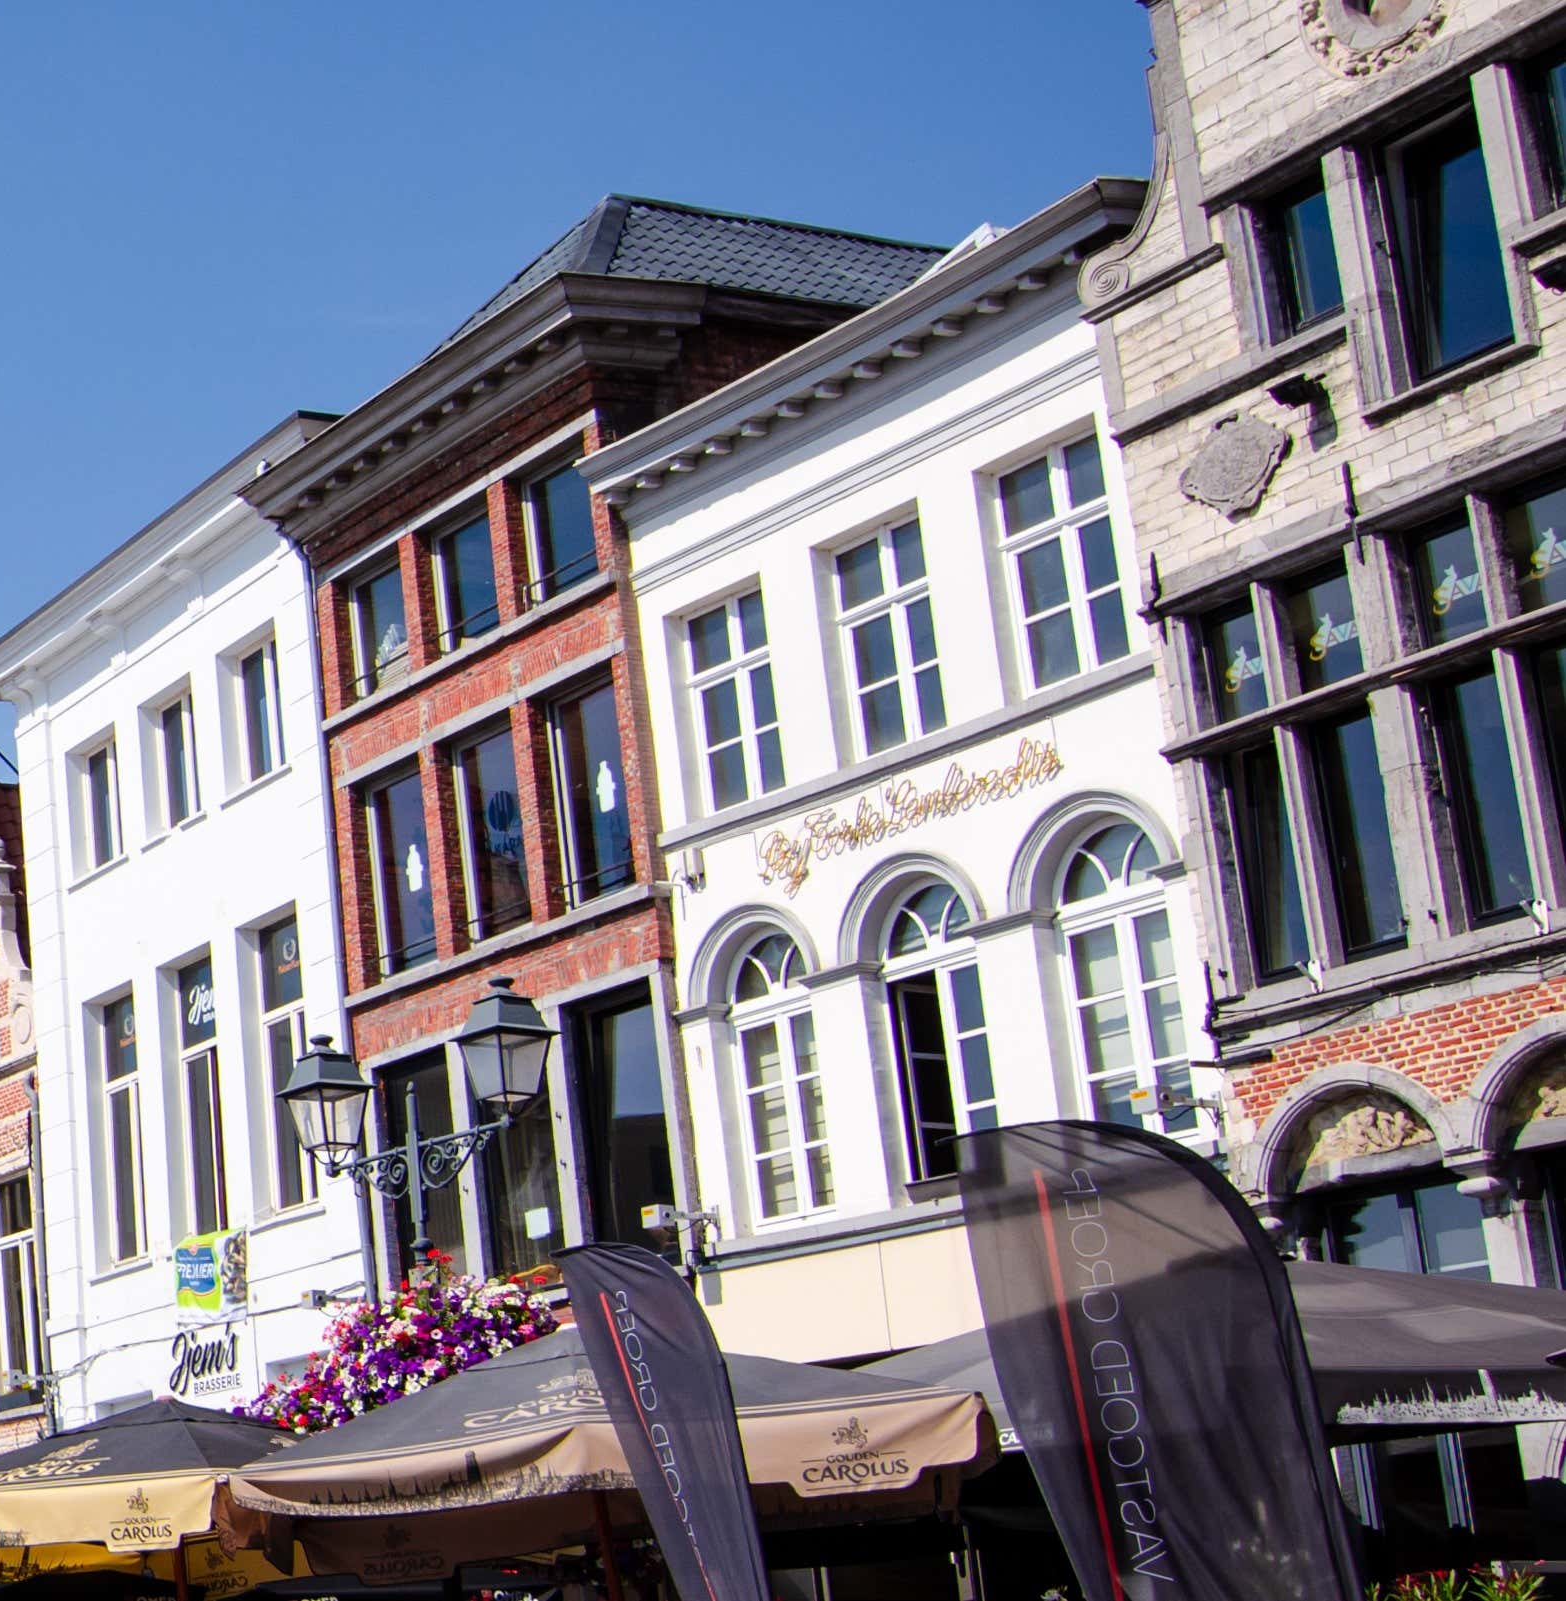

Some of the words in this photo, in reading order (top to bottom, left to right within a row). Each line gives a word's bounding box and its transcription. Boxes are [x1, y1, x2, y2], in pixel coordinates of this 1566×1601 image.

[194, 1373, 242, 1395] BRASSERIE
[464, 1397, 606, 1428] CARO
[826, 1451, 879, 1464] GOUDEN
[802, 1459, 909, 1484] CAROLUS
[110, 1524, 172, 1542] CAROLUS
